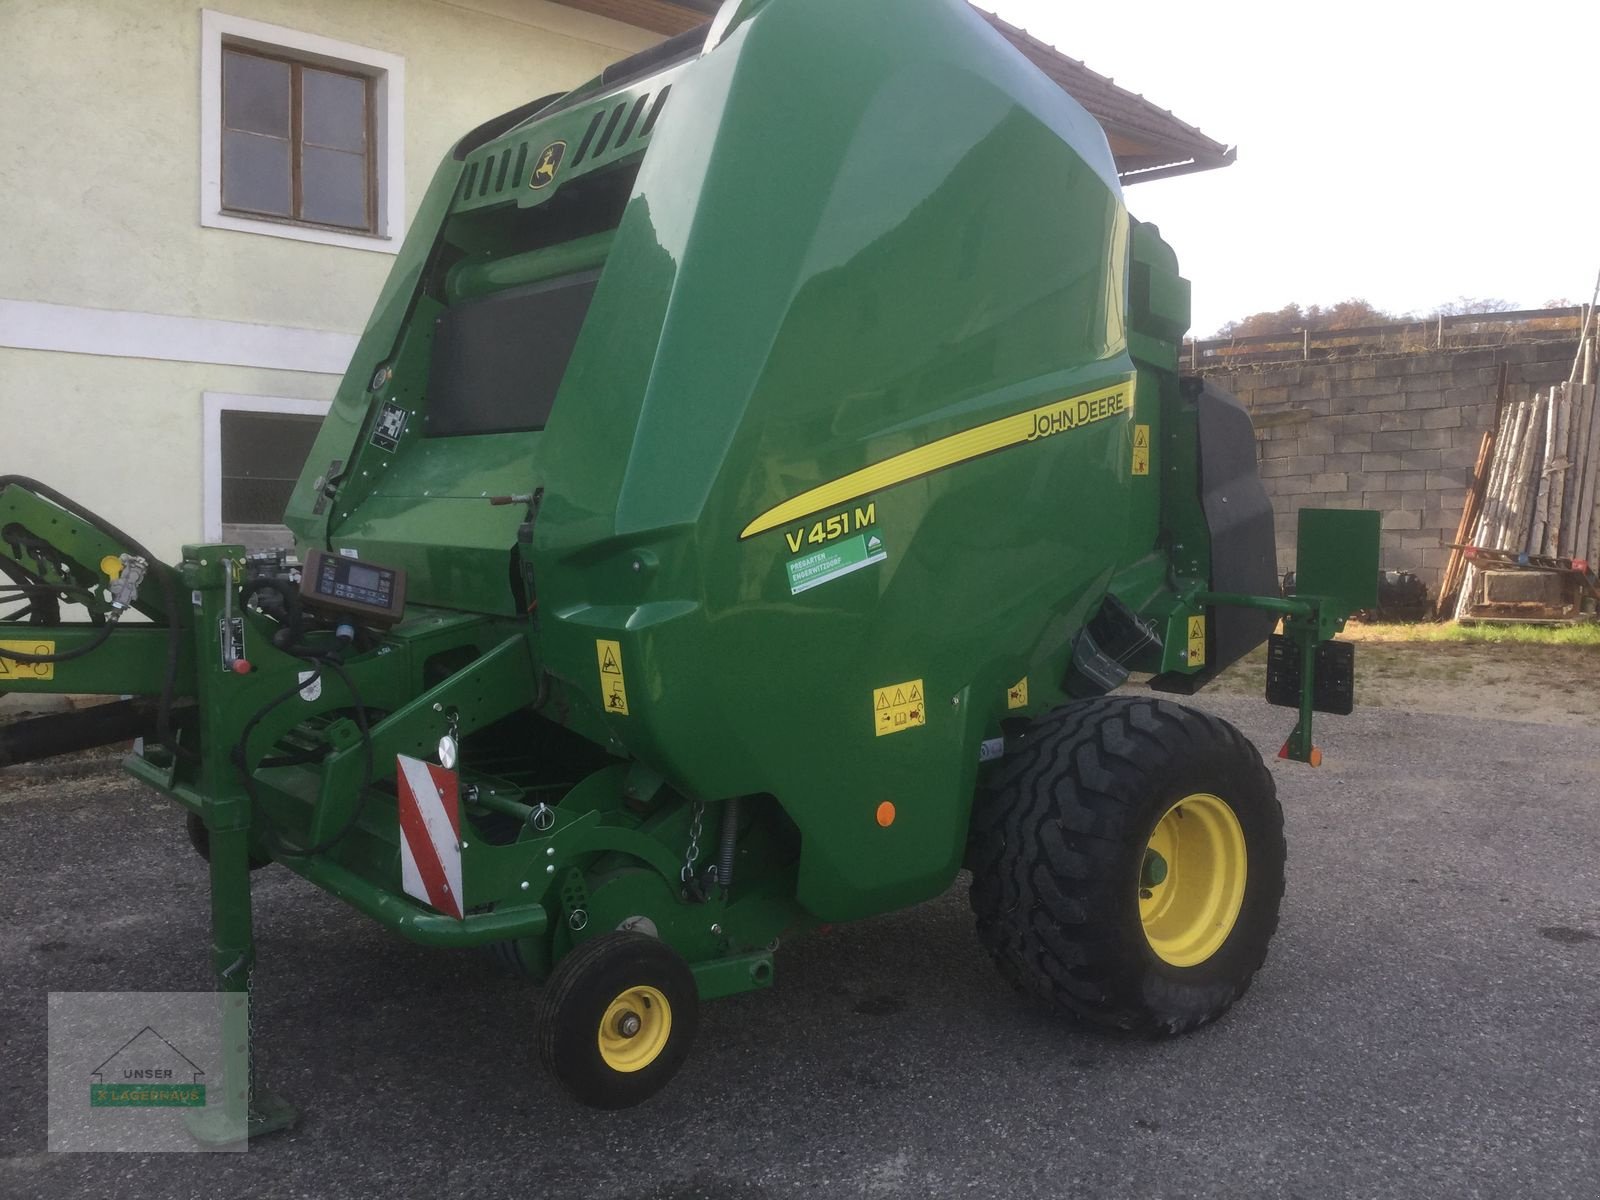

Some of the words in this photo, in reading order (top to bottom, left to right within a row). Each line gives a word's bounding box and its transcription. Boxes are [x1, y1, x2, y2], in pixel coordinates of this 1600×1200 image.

[1028, 407, 1074, 438] JOHN
[1077, 392, 1124, 423] DEERE
[785, 528, 804, 554] V
[808, 512, 849, 544] 451
[855, 503, 875, 530] M
